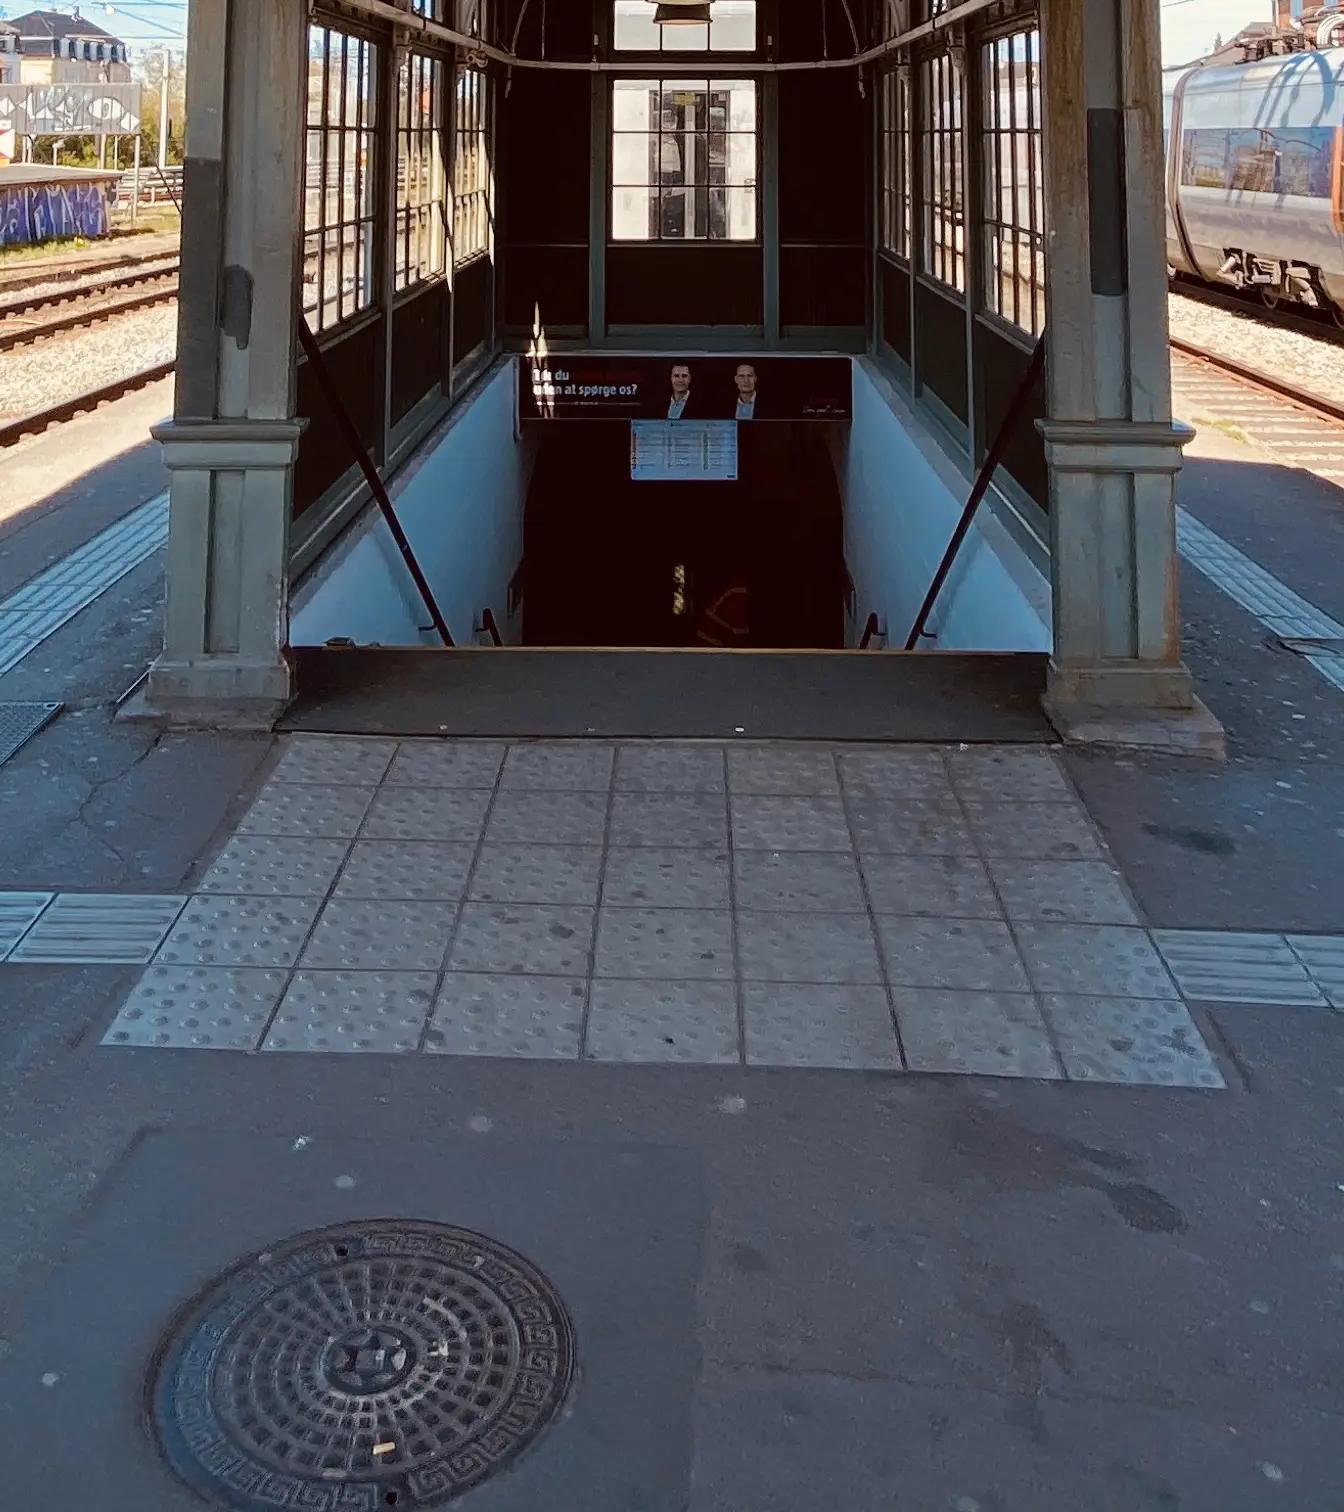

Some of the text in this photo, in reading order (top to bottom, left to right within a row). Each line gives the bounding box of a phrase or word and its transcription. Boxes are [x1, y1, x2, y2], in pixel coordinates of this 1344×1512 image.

[564, 384, 576, 395] at
[578, 385, 617, 397] spørge
[619, 384, 638, 395] os?
